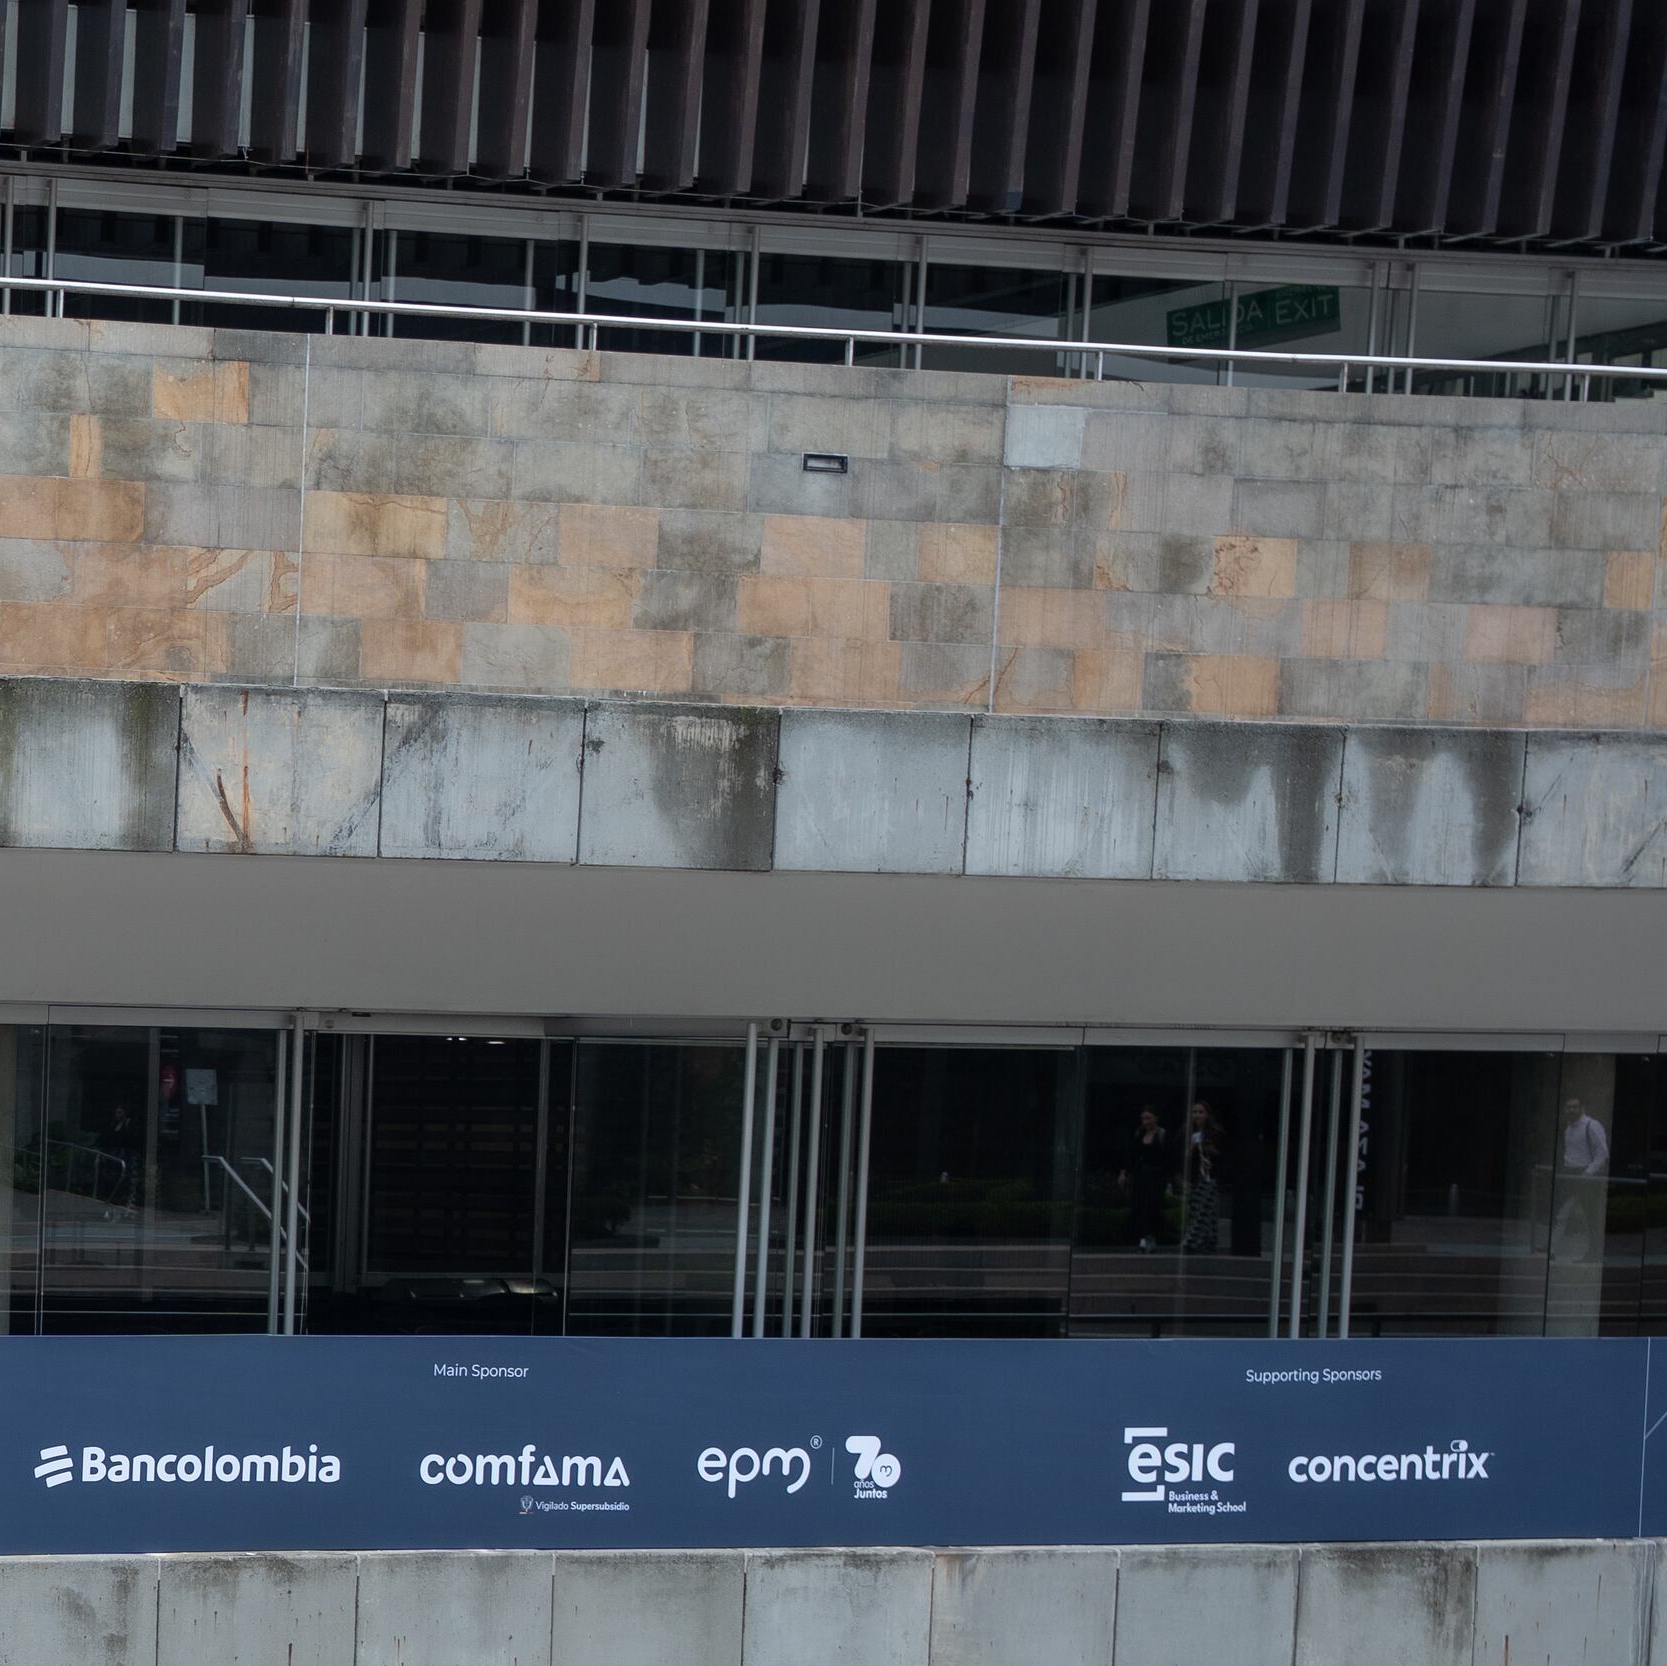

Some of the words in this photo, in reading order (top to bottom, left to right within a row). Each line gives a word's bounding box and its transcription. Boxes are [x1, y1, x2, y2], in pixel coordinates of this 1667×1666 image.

[1275, 294, 1333, 325] EXIT
[433, 1363, 467, 1377] Main
[471, 1364, 529, 1380] Sponsor
[1245, 1368, 1320, 1385] Supporting
[1322, 1368, 1382, 1384] Sponsors
[82, 1444, 341, 1483] Bancolombia
[1289, 1440, 1490, 1483] concentrix
[854, 1479, 875, 1489] años
[854, 1488, 888, 1499] Juntos
[1169, 1490, 1209, 1502] Business
[1210, 1490, 1219, 1501] &
[535, 1501, 569, 1512] Vigilado
[570, 1501, 630, 1512] Supersubsidio
[1168, 1502, 1214, 1515] Marketing
[1216, 1500, 1247, 1514] School
